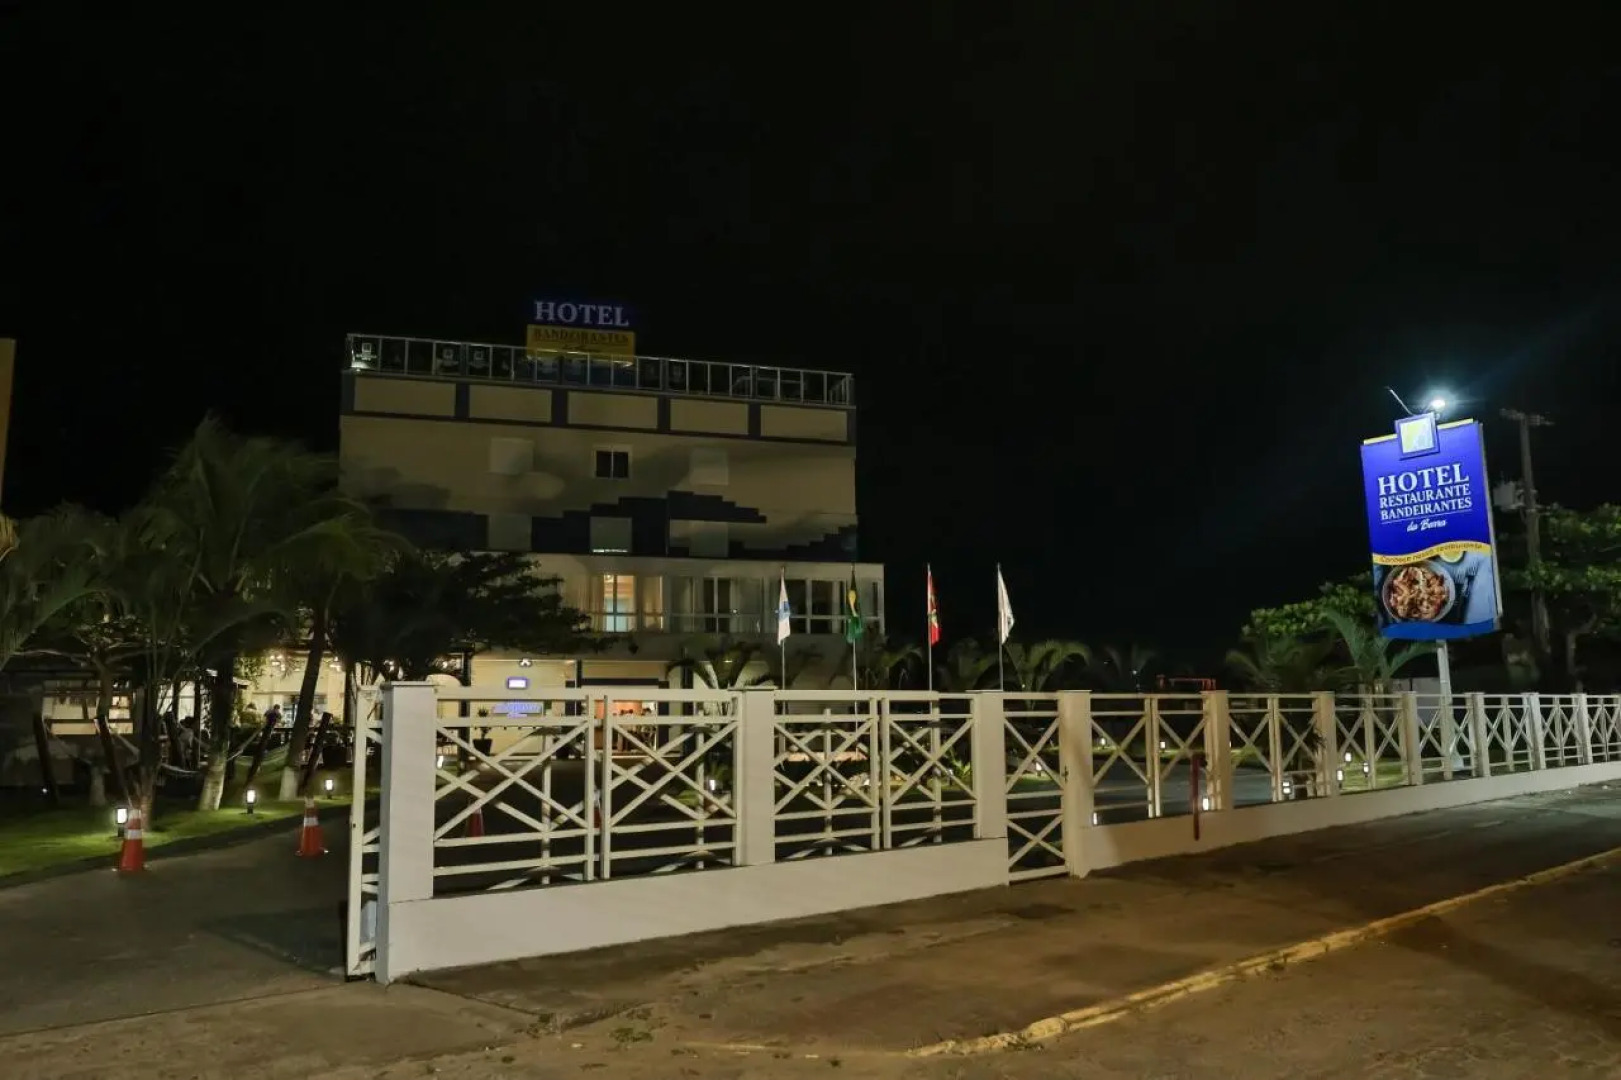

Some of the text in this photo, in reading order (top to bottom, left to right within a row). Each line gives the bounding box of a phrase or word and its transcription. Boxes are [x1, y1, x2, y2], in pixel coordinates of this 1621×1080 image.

[534, 301, 629, 327] HOTEL
[1378, 463, 1469, 496] HOTEL
[1379, 484, 1471, 509] RESTAURANTE
[1380, 497, 1472, 520] BANDEIRANTES
